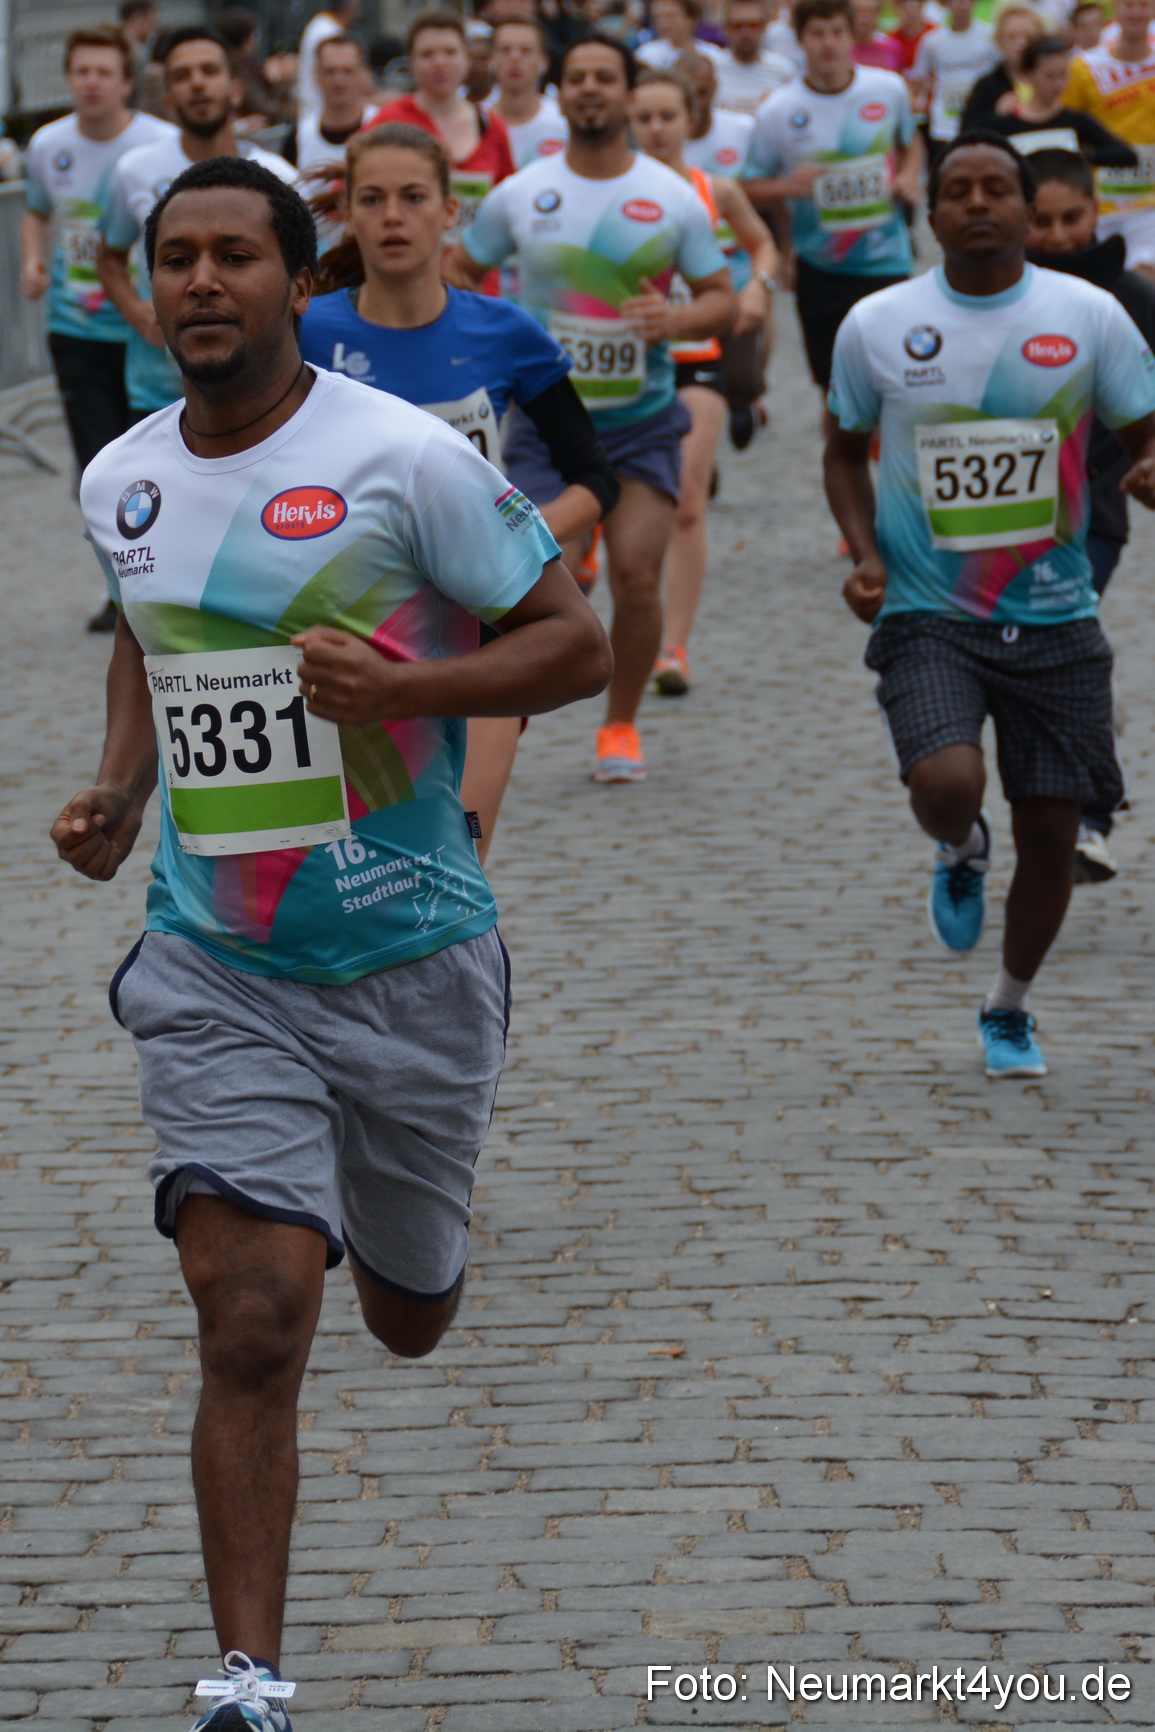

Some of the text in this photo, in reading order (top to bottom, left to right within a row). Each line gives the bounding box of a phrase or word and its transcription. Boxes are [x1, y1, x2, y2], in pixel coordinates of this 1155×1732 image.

[934, 450, 1046, 502] 5327
[272, 500, 337, 525] Hervis
[152, 667, 293, 693] PARTL Neumarkt
[165, 695, 312, 778] 5331
[324, 834, 378, 872] 16.
[335, 852, 433, 893] Neumarkter
[341, 871, 423, 914] Stadtlauf
